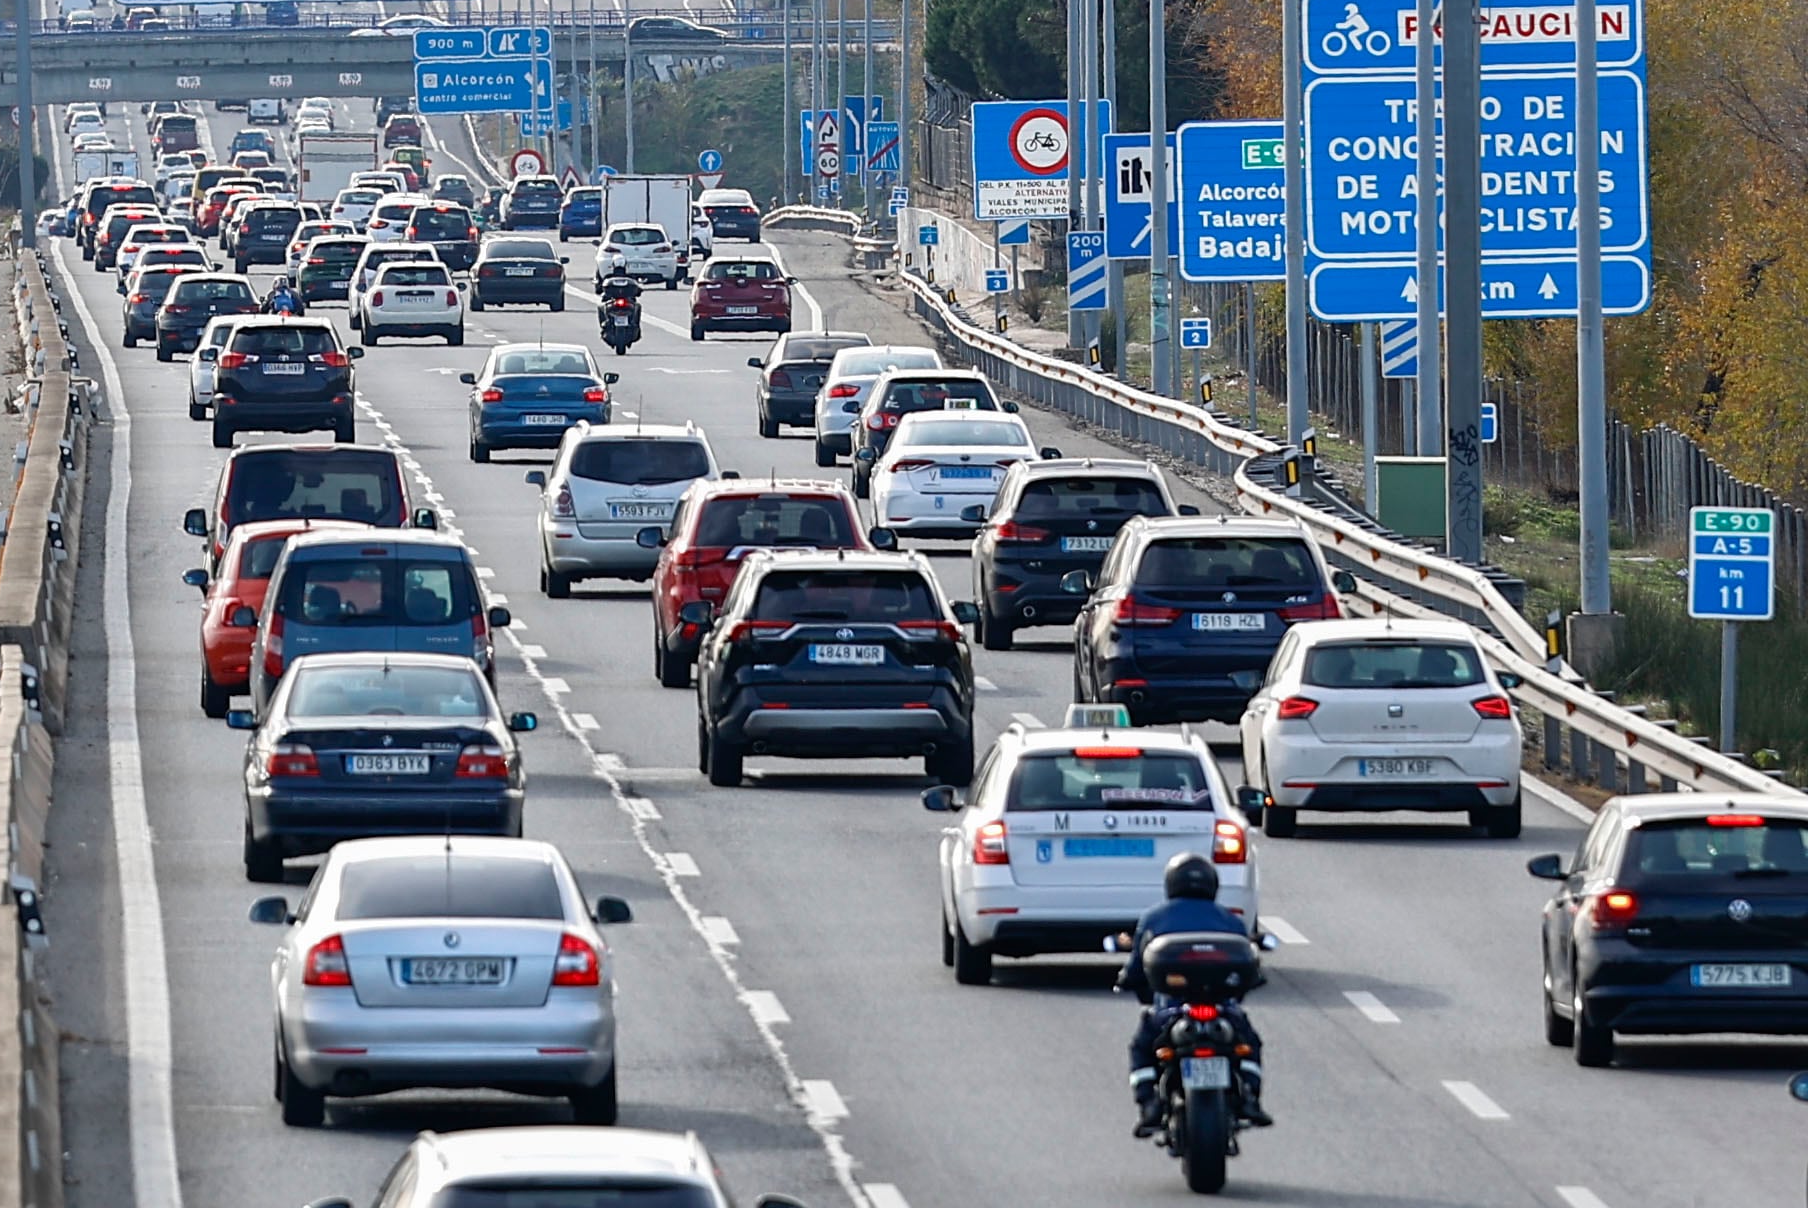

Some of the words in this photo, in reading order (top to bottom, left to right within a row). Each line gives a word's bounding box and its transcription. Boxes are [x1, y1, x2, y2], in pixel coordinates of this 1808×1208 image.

[1405, 11, 1623, 40] PAUCIN
[428, 39, 454, 49] 900
[462, 40, 473, 49] m
[443, 73, 515, 87] Alcorcón
[423, 94, 457, 103] centro
[462, 93, 512, 102] comercial
[1385, 96, 1501, 124] TRAO
[1524, 95, 1565, 120] DE
[1329, 130, 1624, 161] CONCETRACIN
[1247, 144, 1305, 163] E-9
[821, 158, 838, 168] 60
[1337, 175, 1380, 199] DE
[1400, 170, 1615, 198] ADENTS
[1015, 189, 1067, 197] ALTERNATIV
[1198, 183, 1287, 202] Alcorcó
[1024, 198, 1070, 206] MUNICIPA
[1342, 206, 1614, 236] MOTCLISTAS
[1072, 235, 1102, 248] 200
[1199, 234, 1307, 261] Badaj
[1081, 249, 1093, 257] m
[993, 280, 1000, 288] 3
[1191, 333, 1200, 343] 2
[618, 504, 644, 515] 5593
[647, 504, 666, 515] FJV
[1705, 514, 1760, 530] E-90
[1068, 538, 1096, 549] 7312
[1712, 538, 1753, 554] A-5
[1719, 567, 1744, 579] km
[1719, 586, 1744, 609] 11
[1201, 615, 1232, 627] 6118
[1238, 614, 1261, 626] HZL
[819, 644, 851, 657] 4848
[855, 645, 880, 657] MGR
[356, 755, 393, 769] 0363
[397, 755, 426, 769] BYK
[1054, 813, 1070, 831] M
[414, 959, 459, 978] 4672
[1702, 965, 1746, 983] 5775
[1753, 965, 1784, 982] KJB
